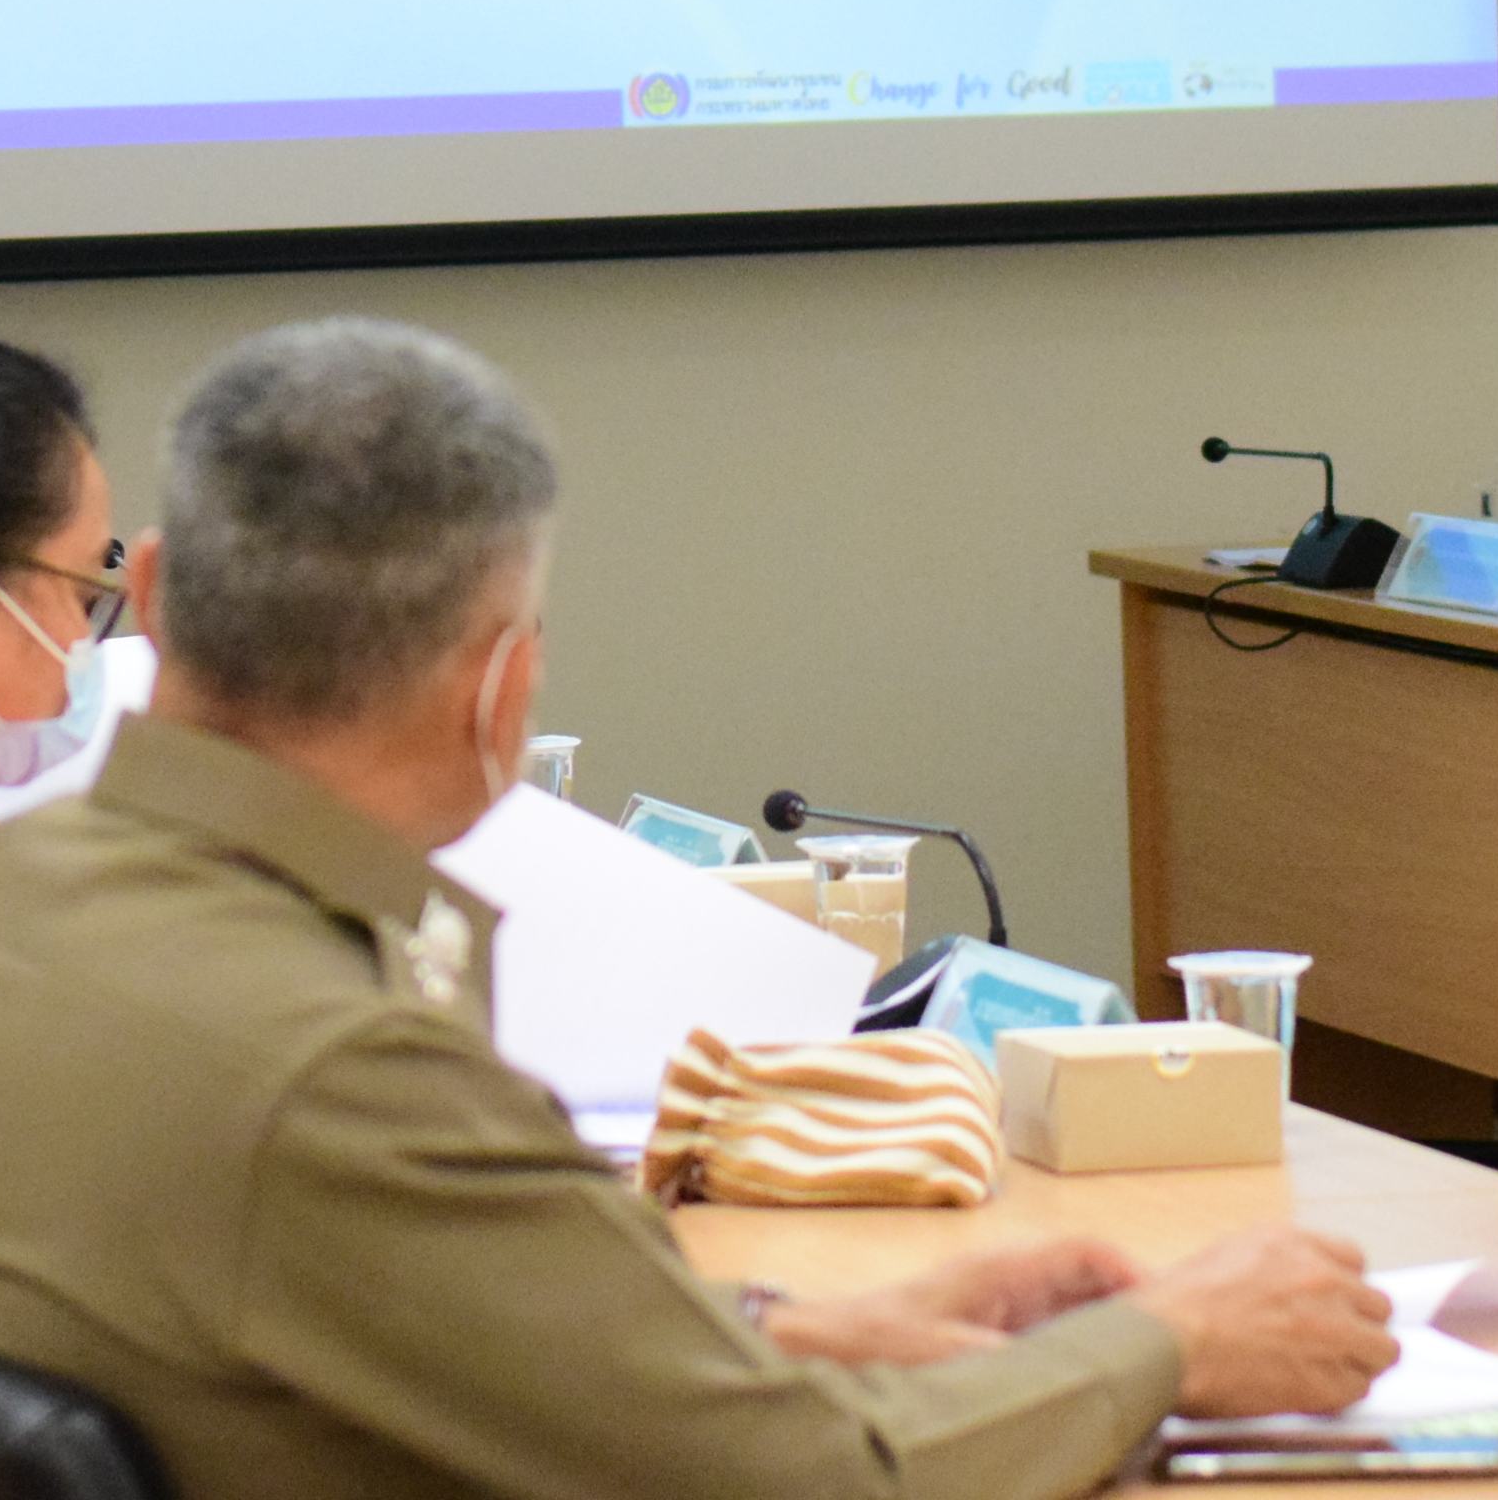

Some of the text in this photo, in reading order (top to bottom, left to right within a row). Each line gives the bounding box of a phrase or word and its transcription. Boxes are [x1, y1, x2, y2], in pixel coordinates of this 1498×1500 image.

[849, 68, 943, 110] Change
[954, 70, 994, 109] for
[1006, 62, 1072, 102] Good
